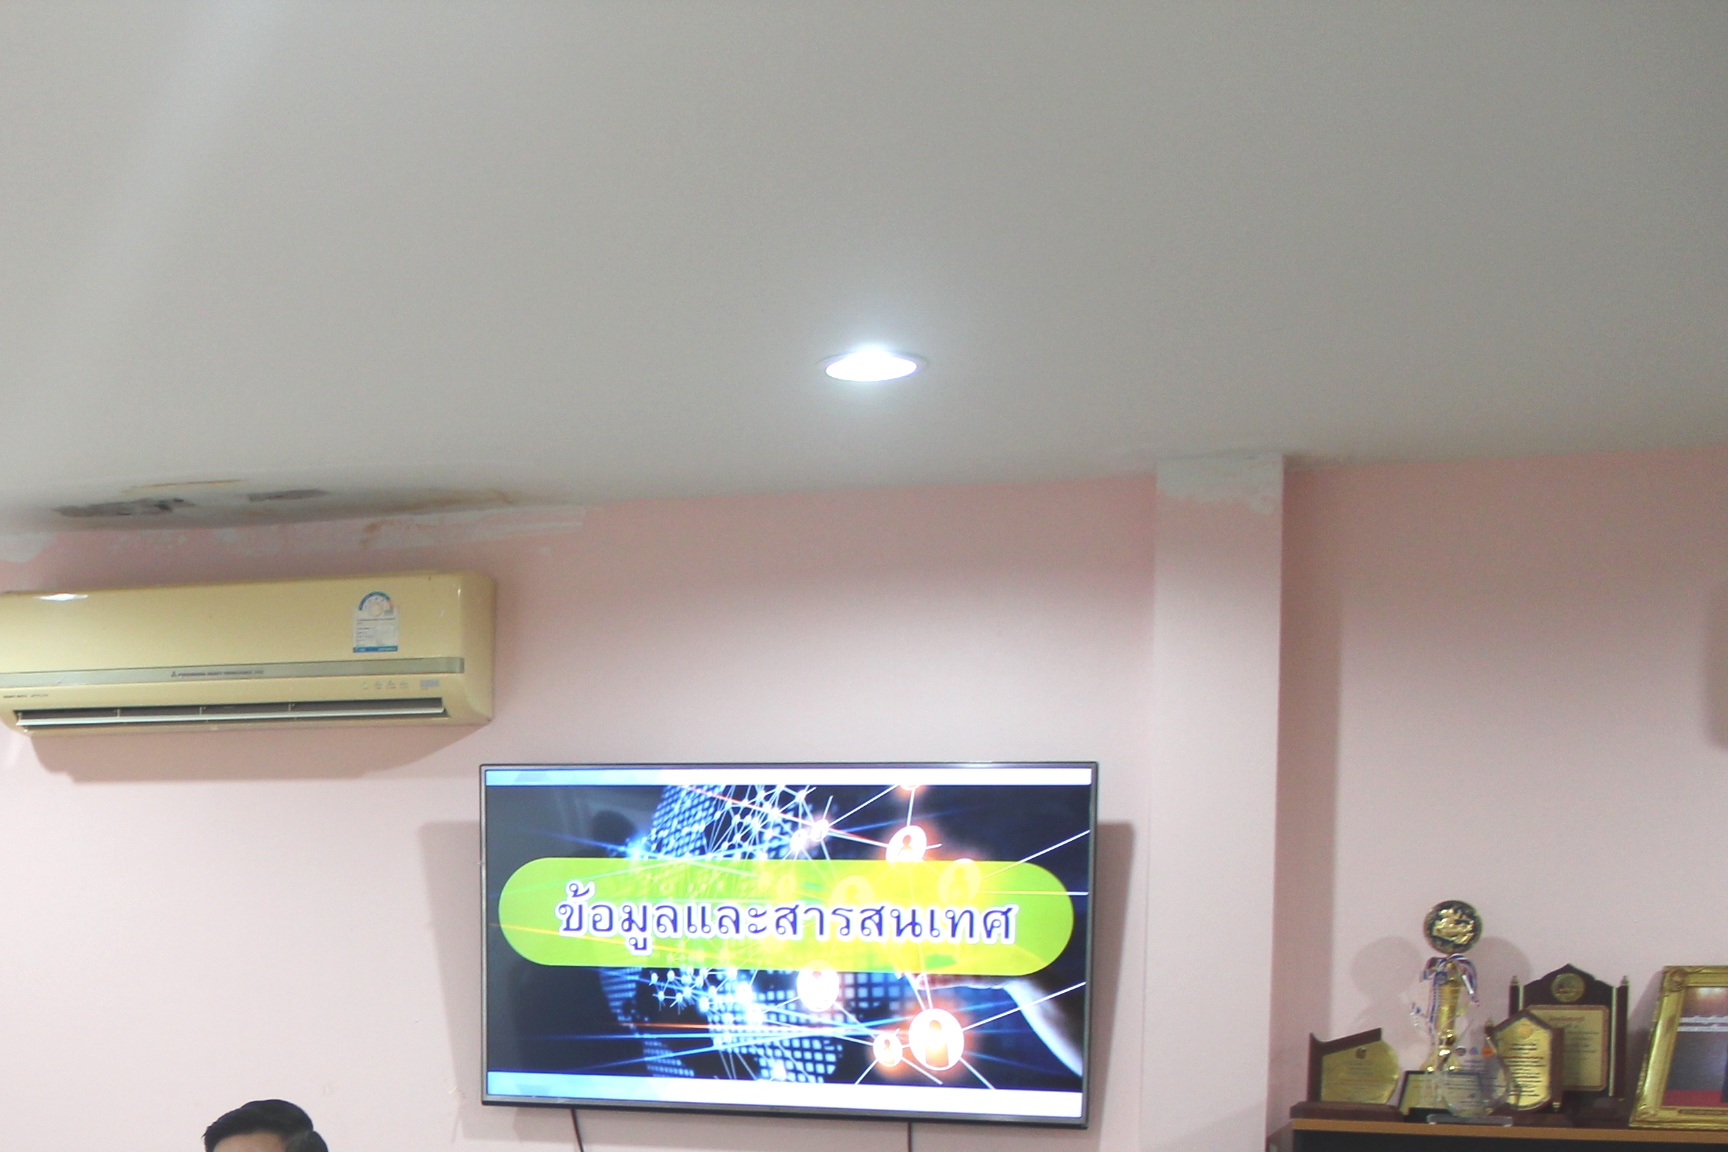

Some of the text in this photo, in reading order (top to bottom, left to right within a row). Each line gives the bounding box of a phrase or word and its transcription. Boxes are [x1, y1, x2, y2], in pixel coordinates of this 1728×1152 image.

[557, 881, 1018, 954] ข้อมูลและสารสนเทศ
